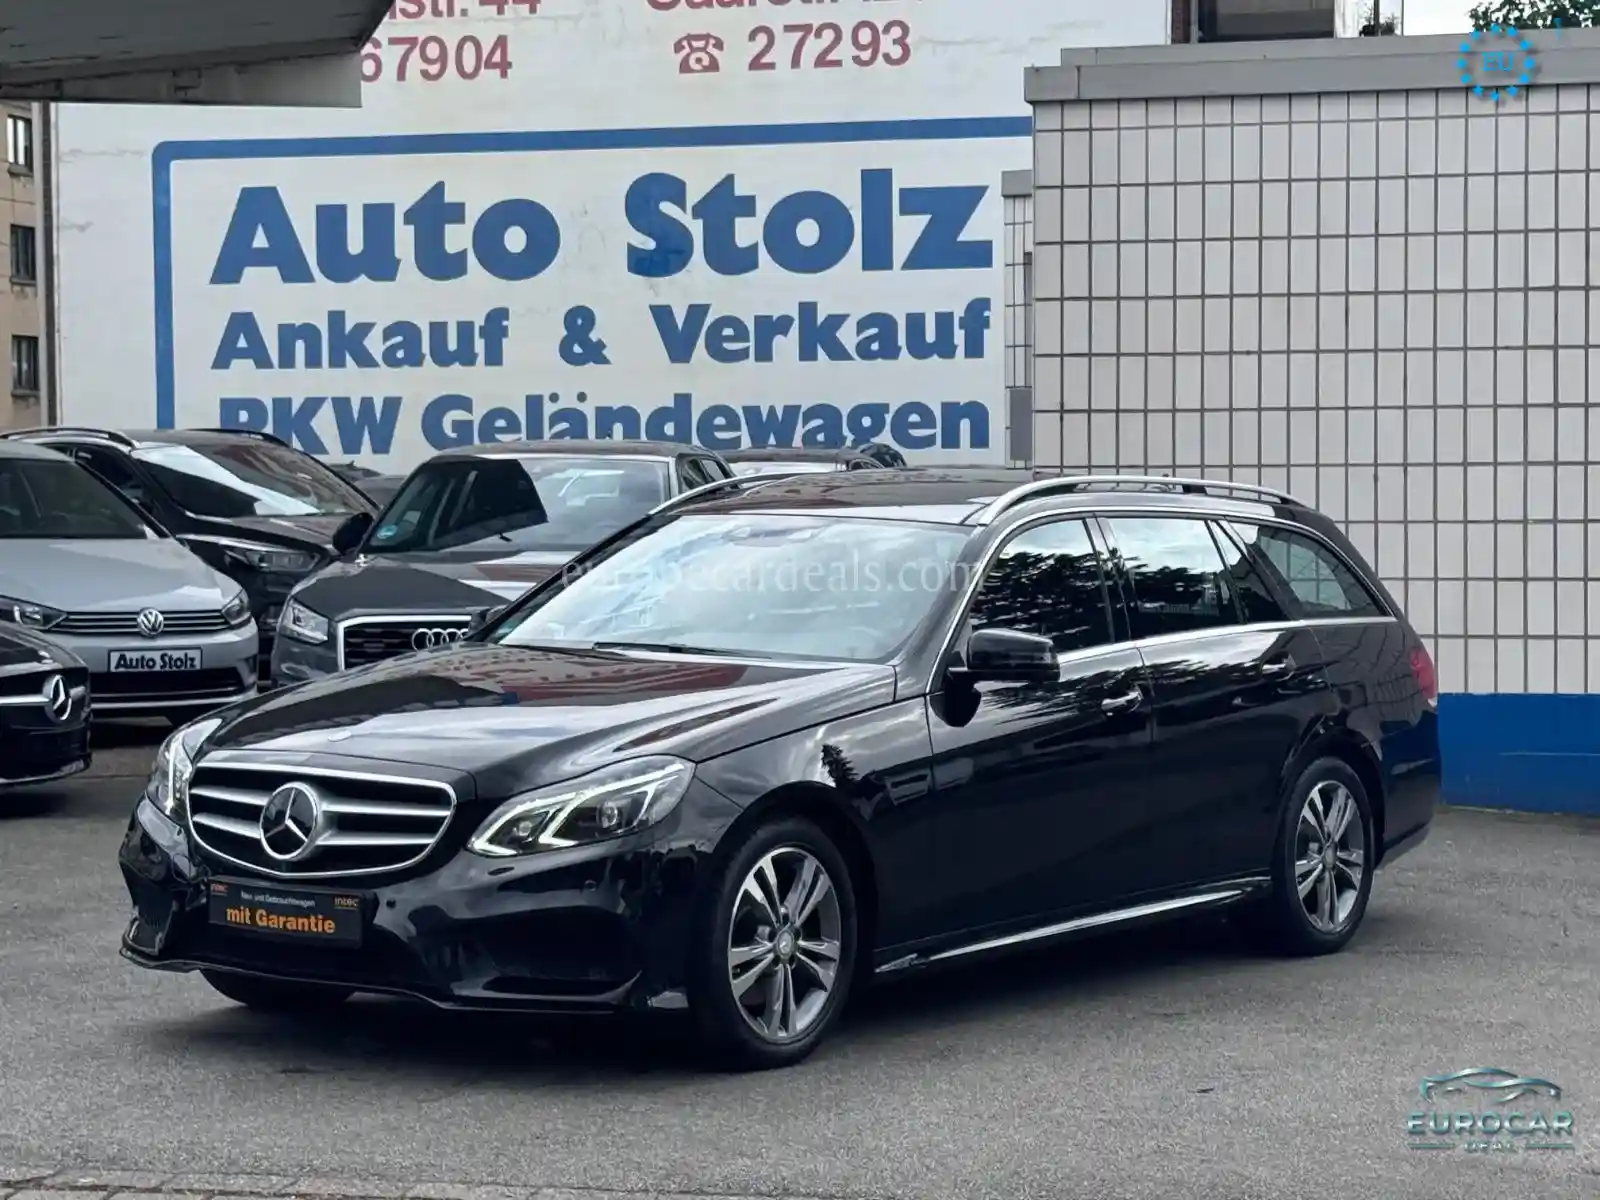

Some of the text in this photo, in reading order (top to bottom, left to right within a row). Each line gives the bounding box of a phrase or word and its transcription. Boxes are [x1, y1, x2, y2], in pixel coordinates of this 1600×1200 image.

[748, 20, 911, 71] 27293
[209, 168, 993, 285] Auto Stolz
[211, 297, 991, 370] Ankauf & Verkauf
[219, 391, 990, 455] PKW Geländewagen
[114, 652, 196, 670] Auto Stolz
[226, 905, 335, 933] mit Garantie
